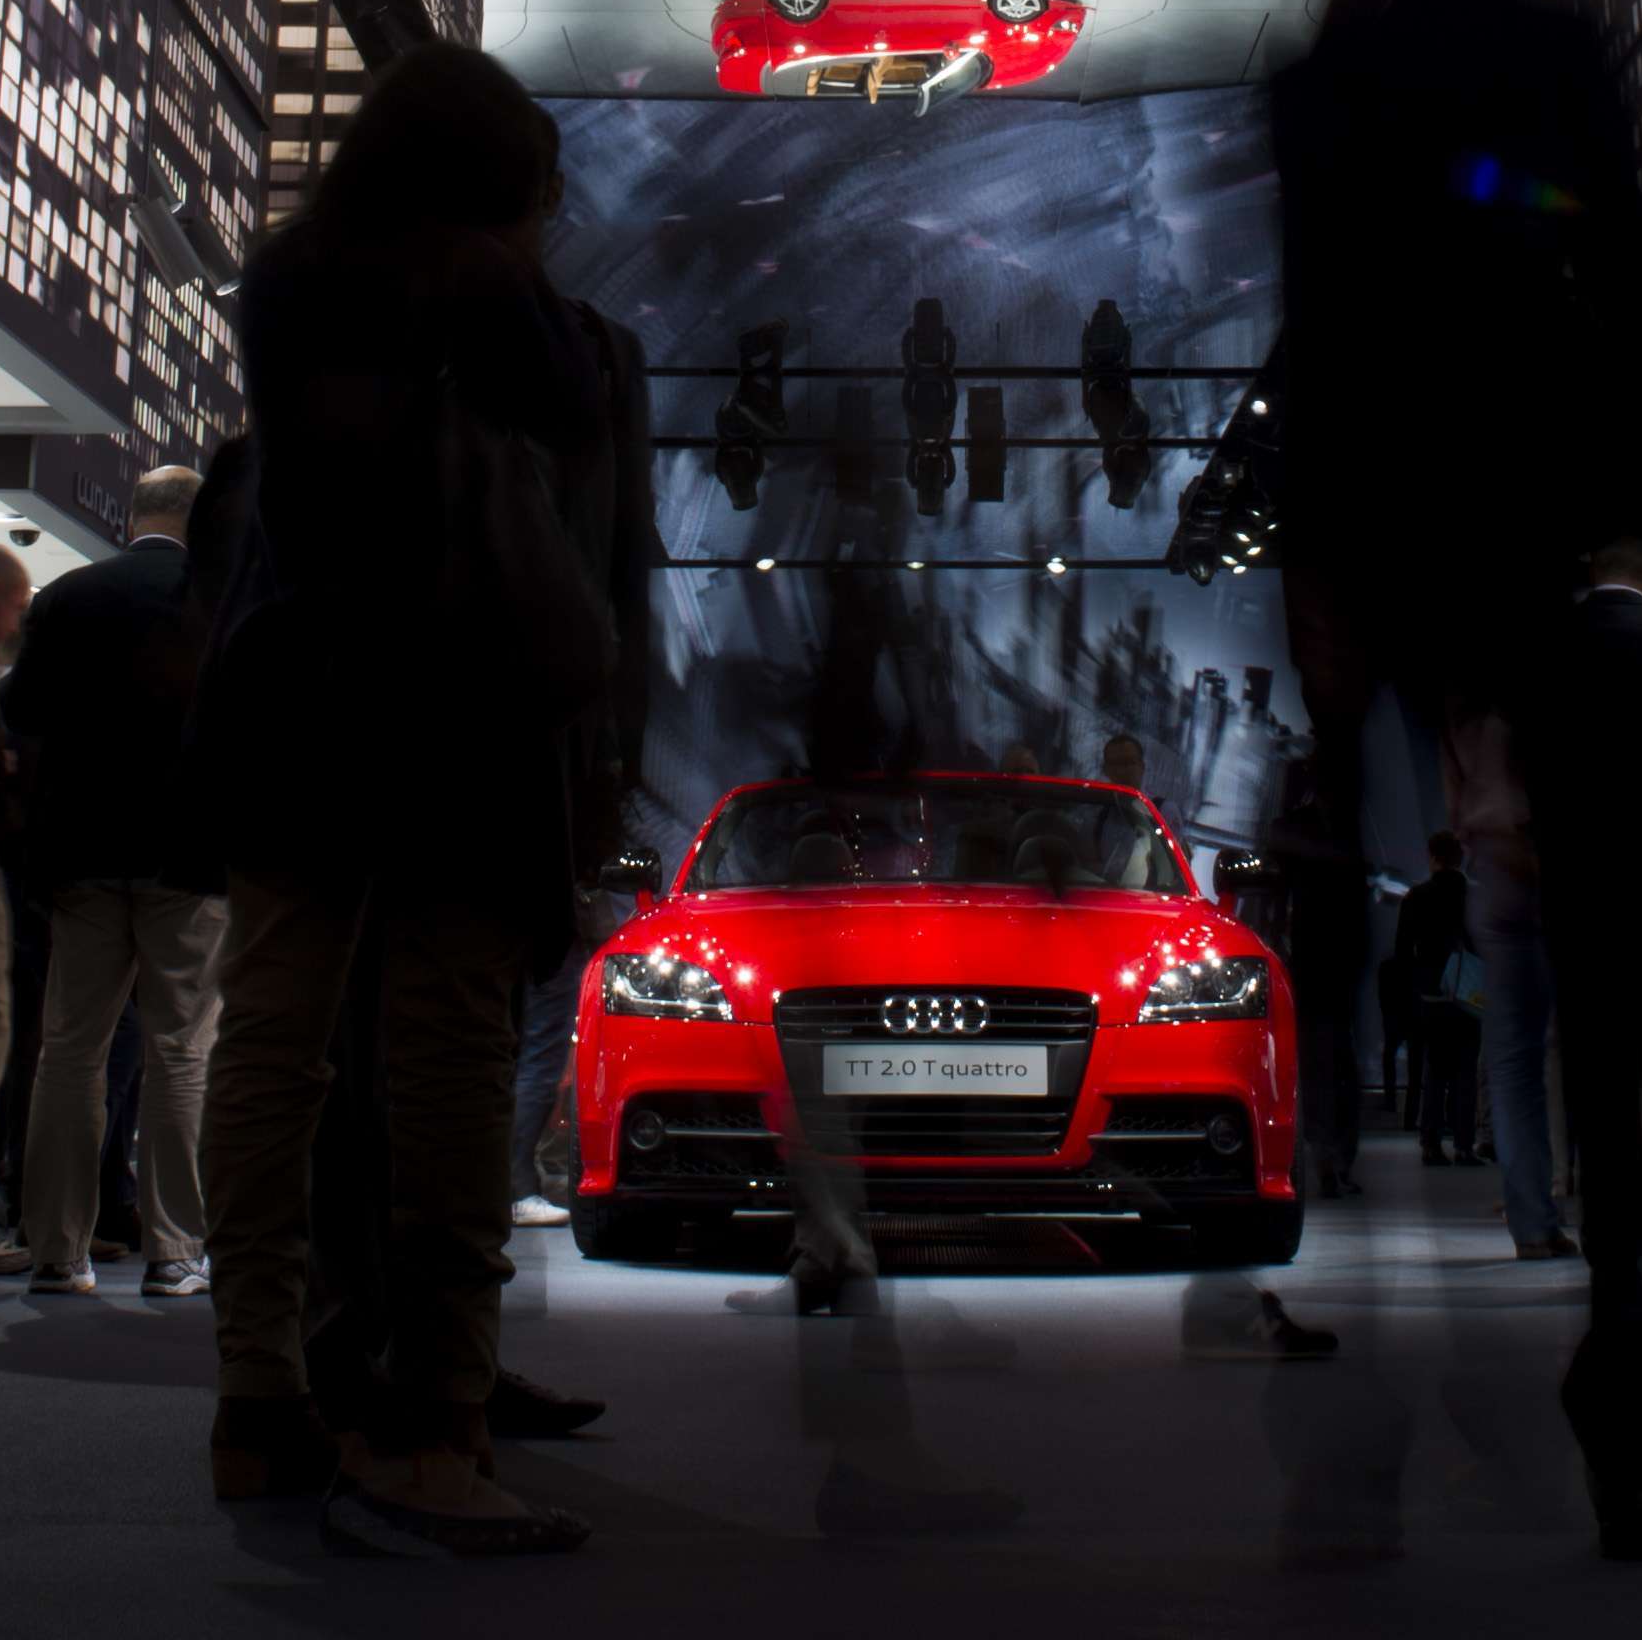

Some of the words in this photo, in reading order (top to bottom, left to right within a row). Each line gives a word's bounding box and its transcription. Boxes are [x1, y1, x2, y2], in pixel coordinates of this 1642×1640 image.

[845, 1059, 874, 1077] TT
[880, 1059, 917, 1077] 2.0
[923, 1059, 937, 1077] T
[940, 1061, 1028, 1080] quattro
